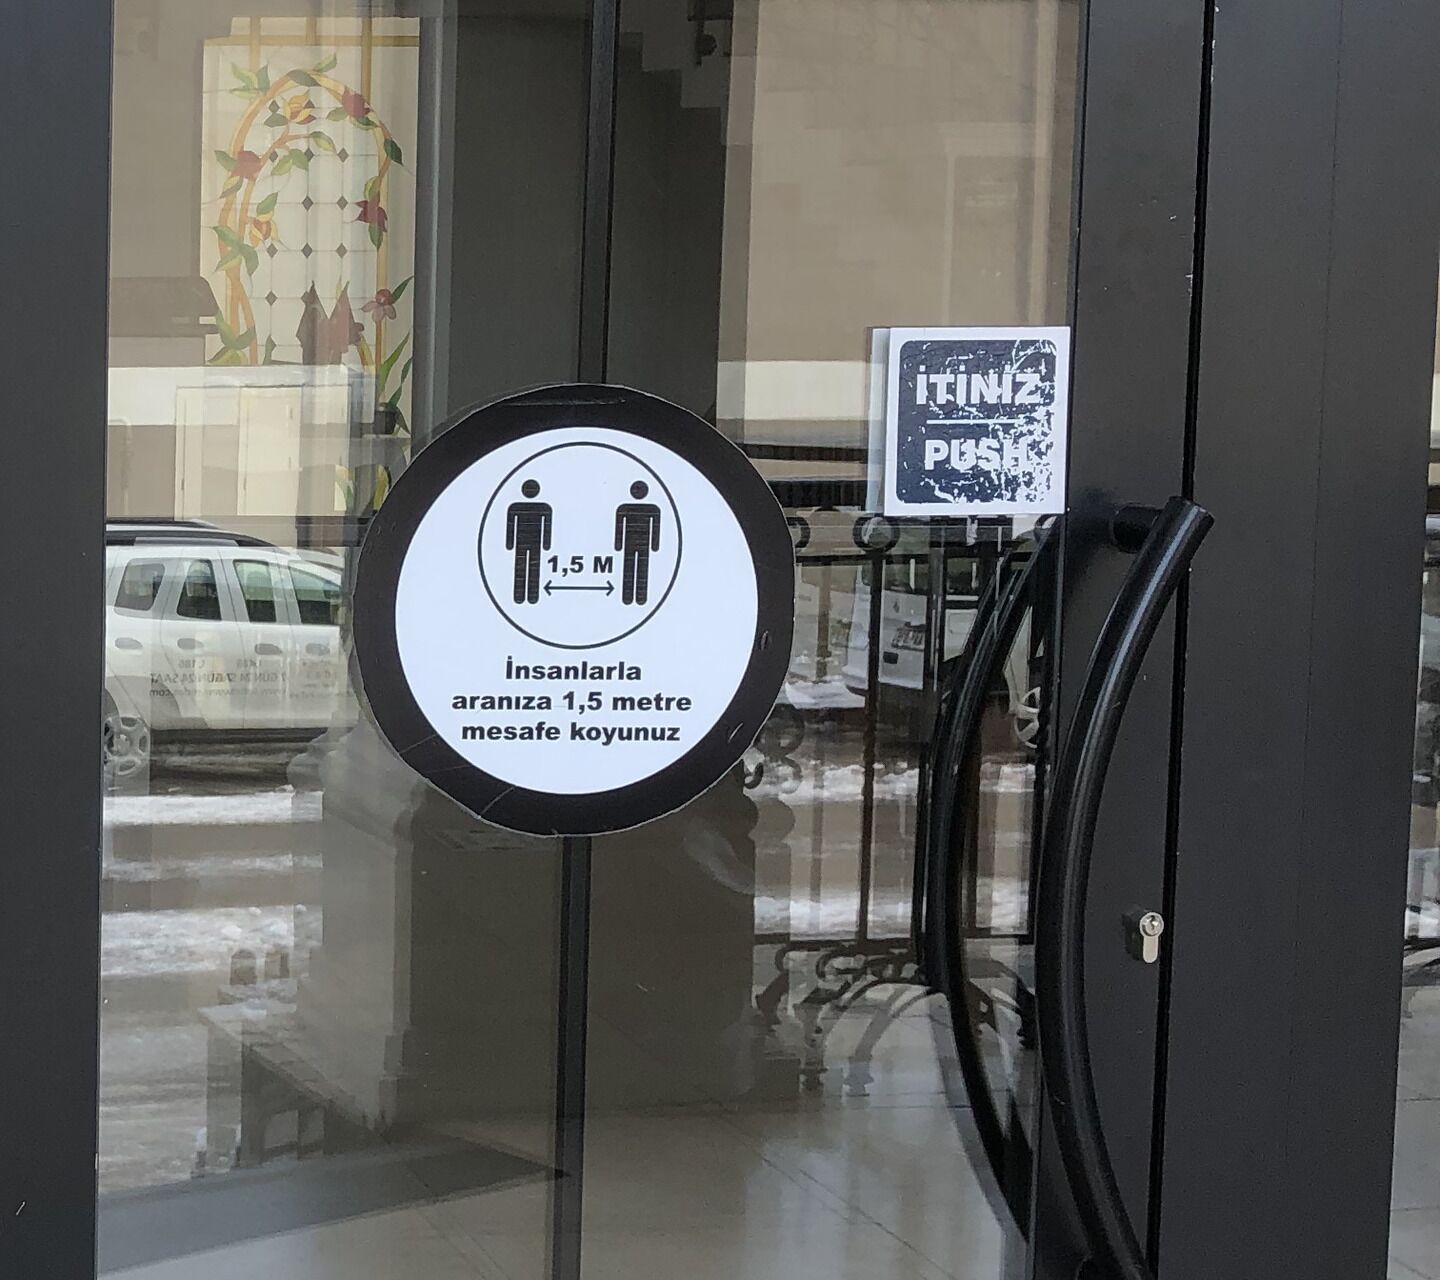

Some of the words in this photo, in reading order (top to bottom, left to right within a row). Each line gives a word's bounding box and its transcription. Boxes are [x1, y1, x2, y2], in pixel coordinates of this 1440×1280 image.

[916, 364, 1042, 405] İTİNİZ
[924, 438, 1030, 472] PUSH
[547, 554, 585, 577] 1,5
[593, 555, 614, 574] M
[505, 655, 642, 681] İnsanlarla
[452, 693, 552, 711] aranıza
[563, 690, 603, 715] 1,5
[612, 692, 692, 711] metre
[461, 721, 560, 741] mesafe
[570, 722, 681, 746] koyunuz
